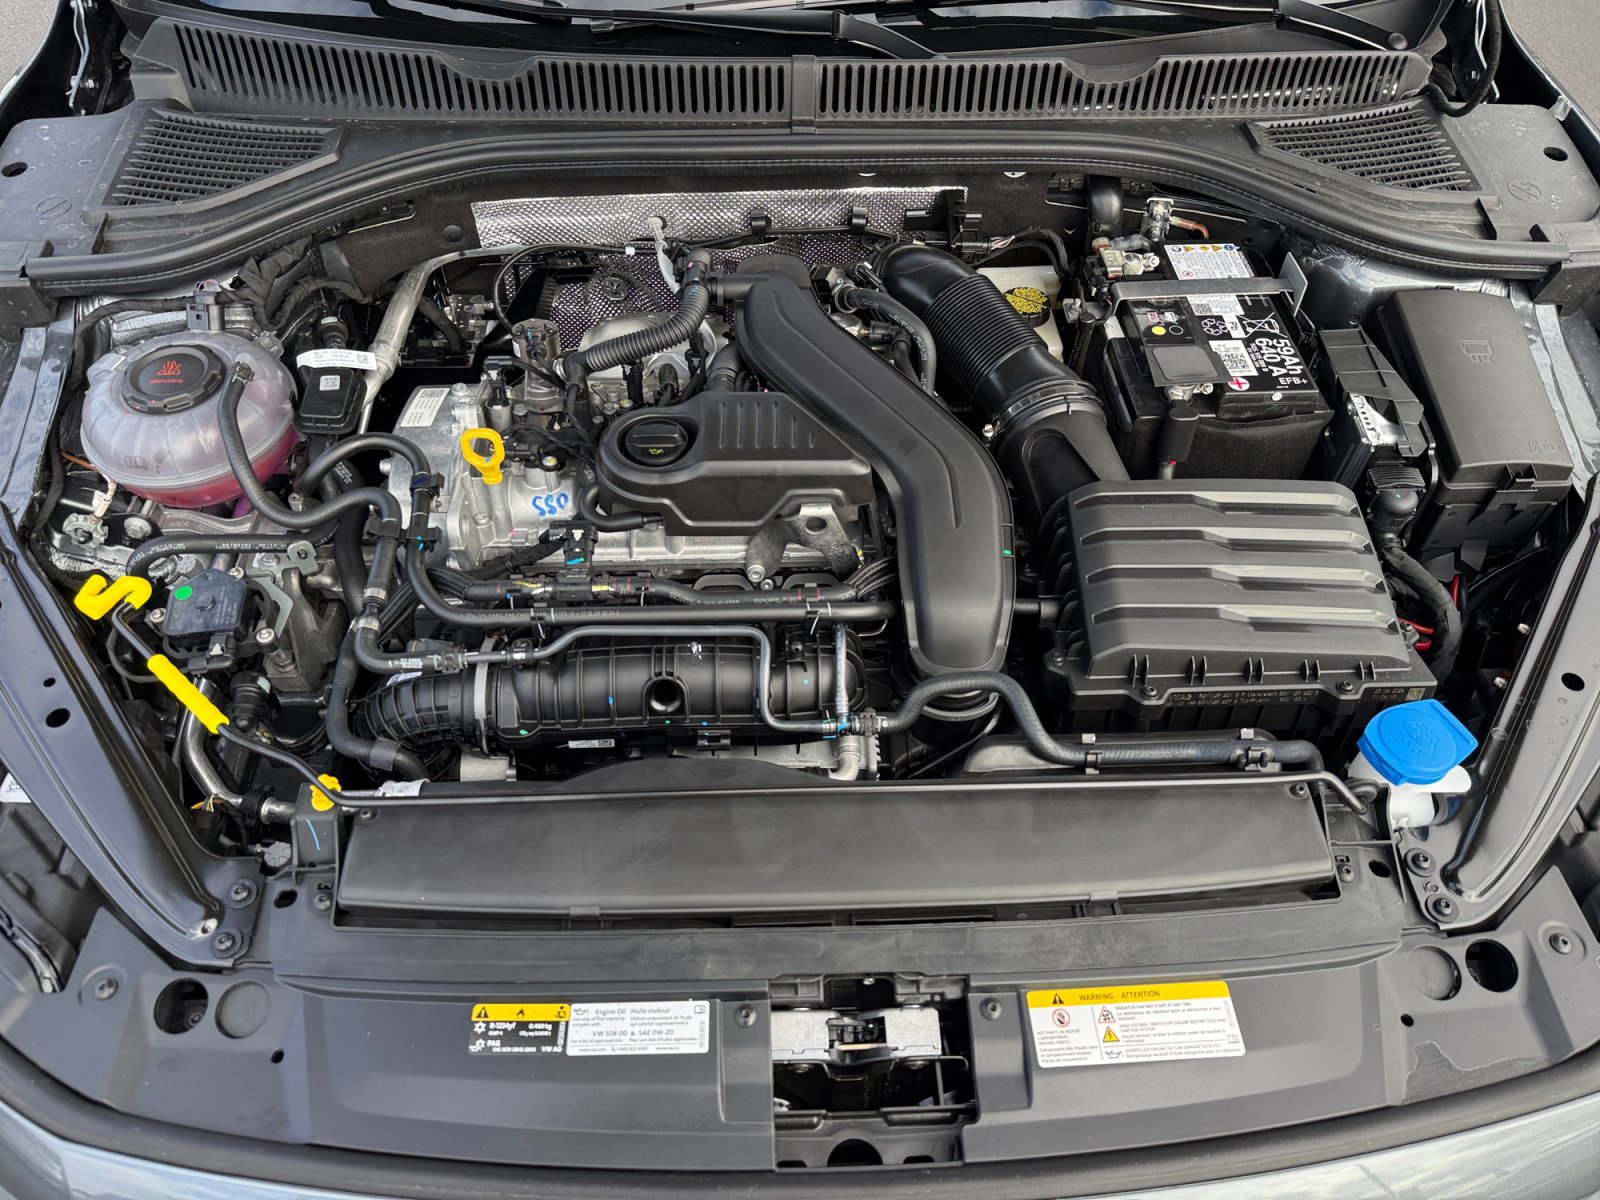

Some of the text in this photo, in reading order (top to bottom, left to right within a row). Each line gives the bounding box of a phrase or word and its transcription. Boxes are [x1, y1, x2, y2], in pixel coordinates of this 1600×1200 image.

[1255, 338, 1281, 363] 640
[1268, 366, 1288, 377] A
[1272, 339, 1304, 375] 59Ah
[1278, 376, 1308, 385] EFB+
[1078, 990, 1161, 1001] WARNING ATTENTION
[486, 1039, 501, 1047] PAG
